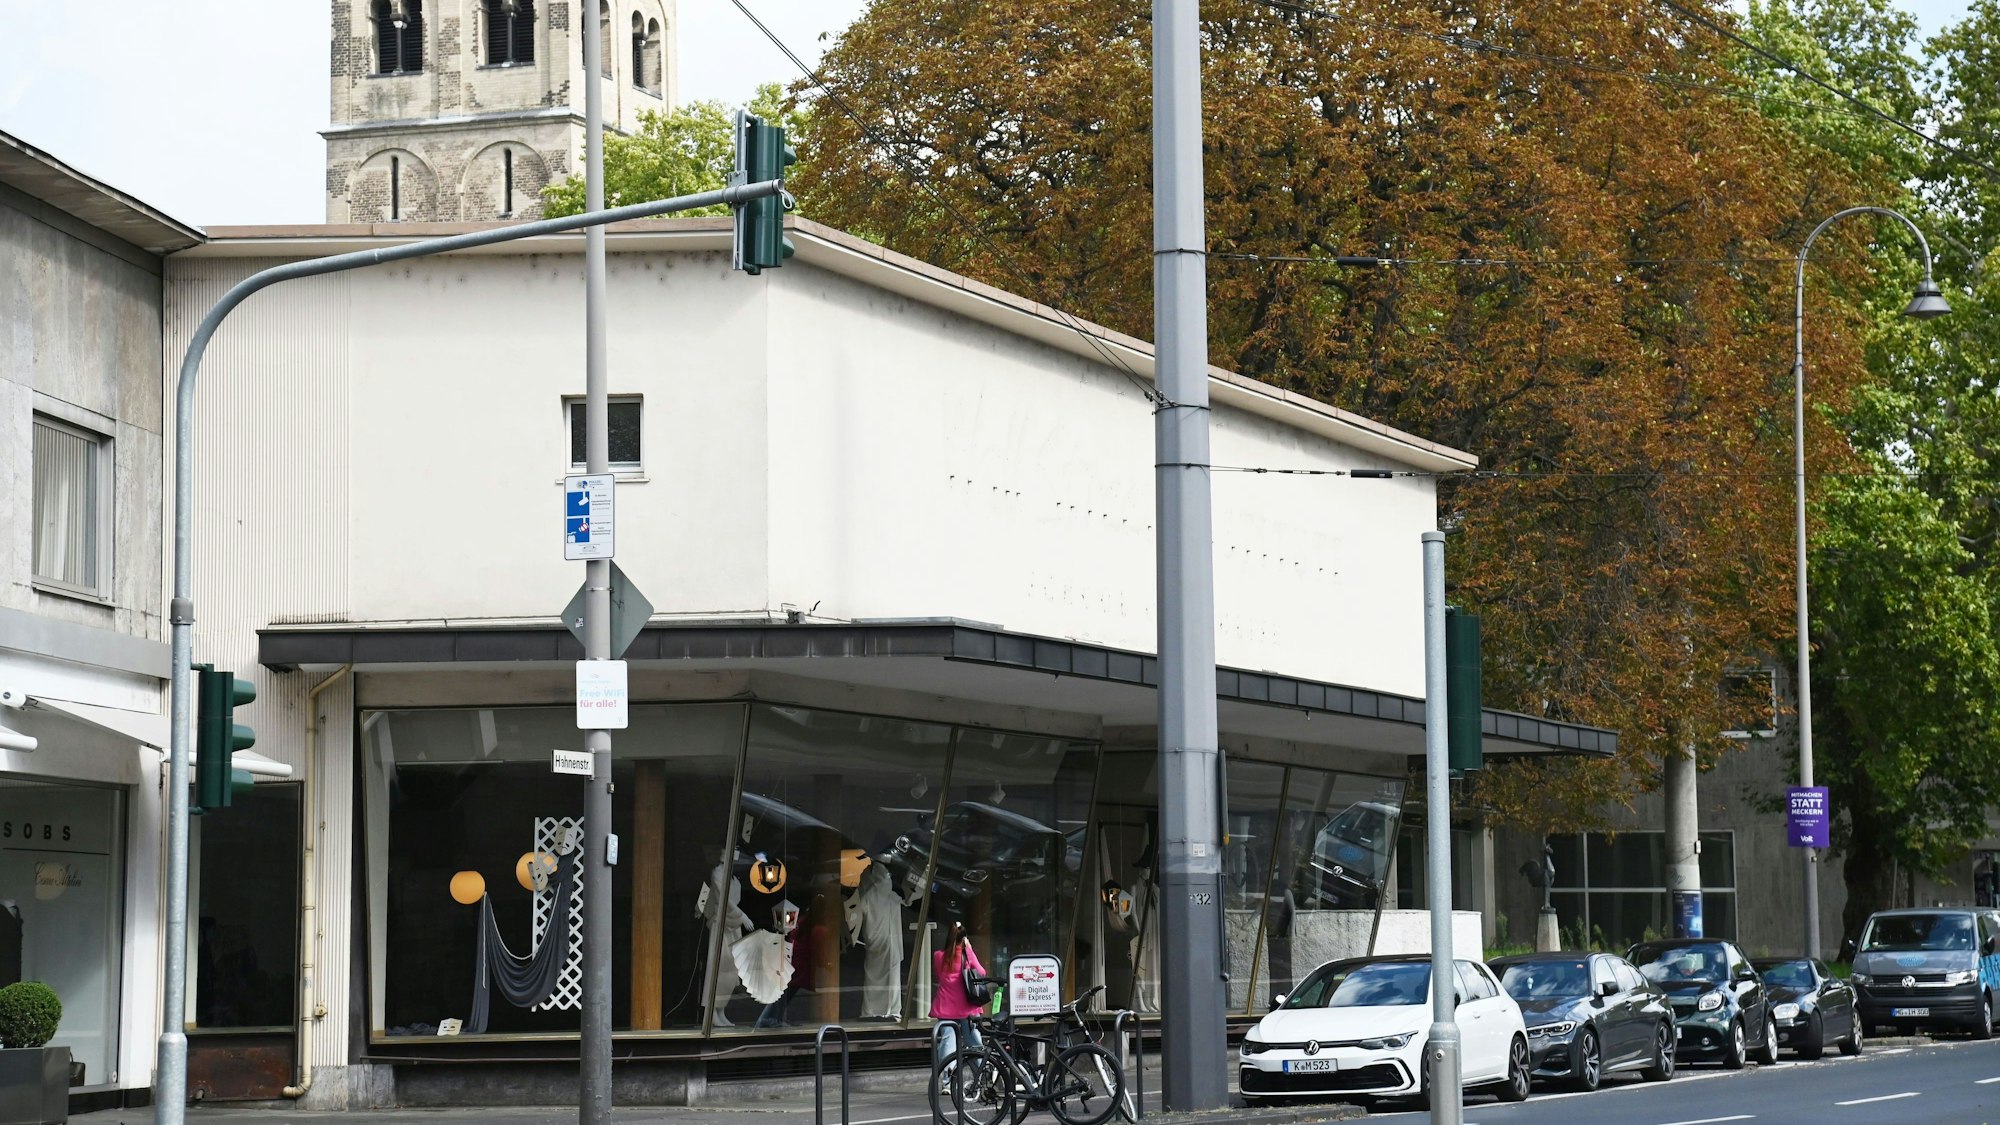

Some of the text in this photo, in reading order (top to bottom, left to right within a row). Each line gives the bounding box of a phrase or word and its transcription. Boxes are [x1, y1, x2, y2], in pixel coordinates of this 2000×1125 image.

[580, 689, 600, 697] Free
[580, 699, 617, 708] für alle!
[555, 754, 591, 770] Hahnenstr.
[1791, 799, 1823, 808] STATT
[1800, 835, 1814, 843] Volt
[1028, 985, 1049, 994] Digital
[1294, 1062, 1300, 1071] K
